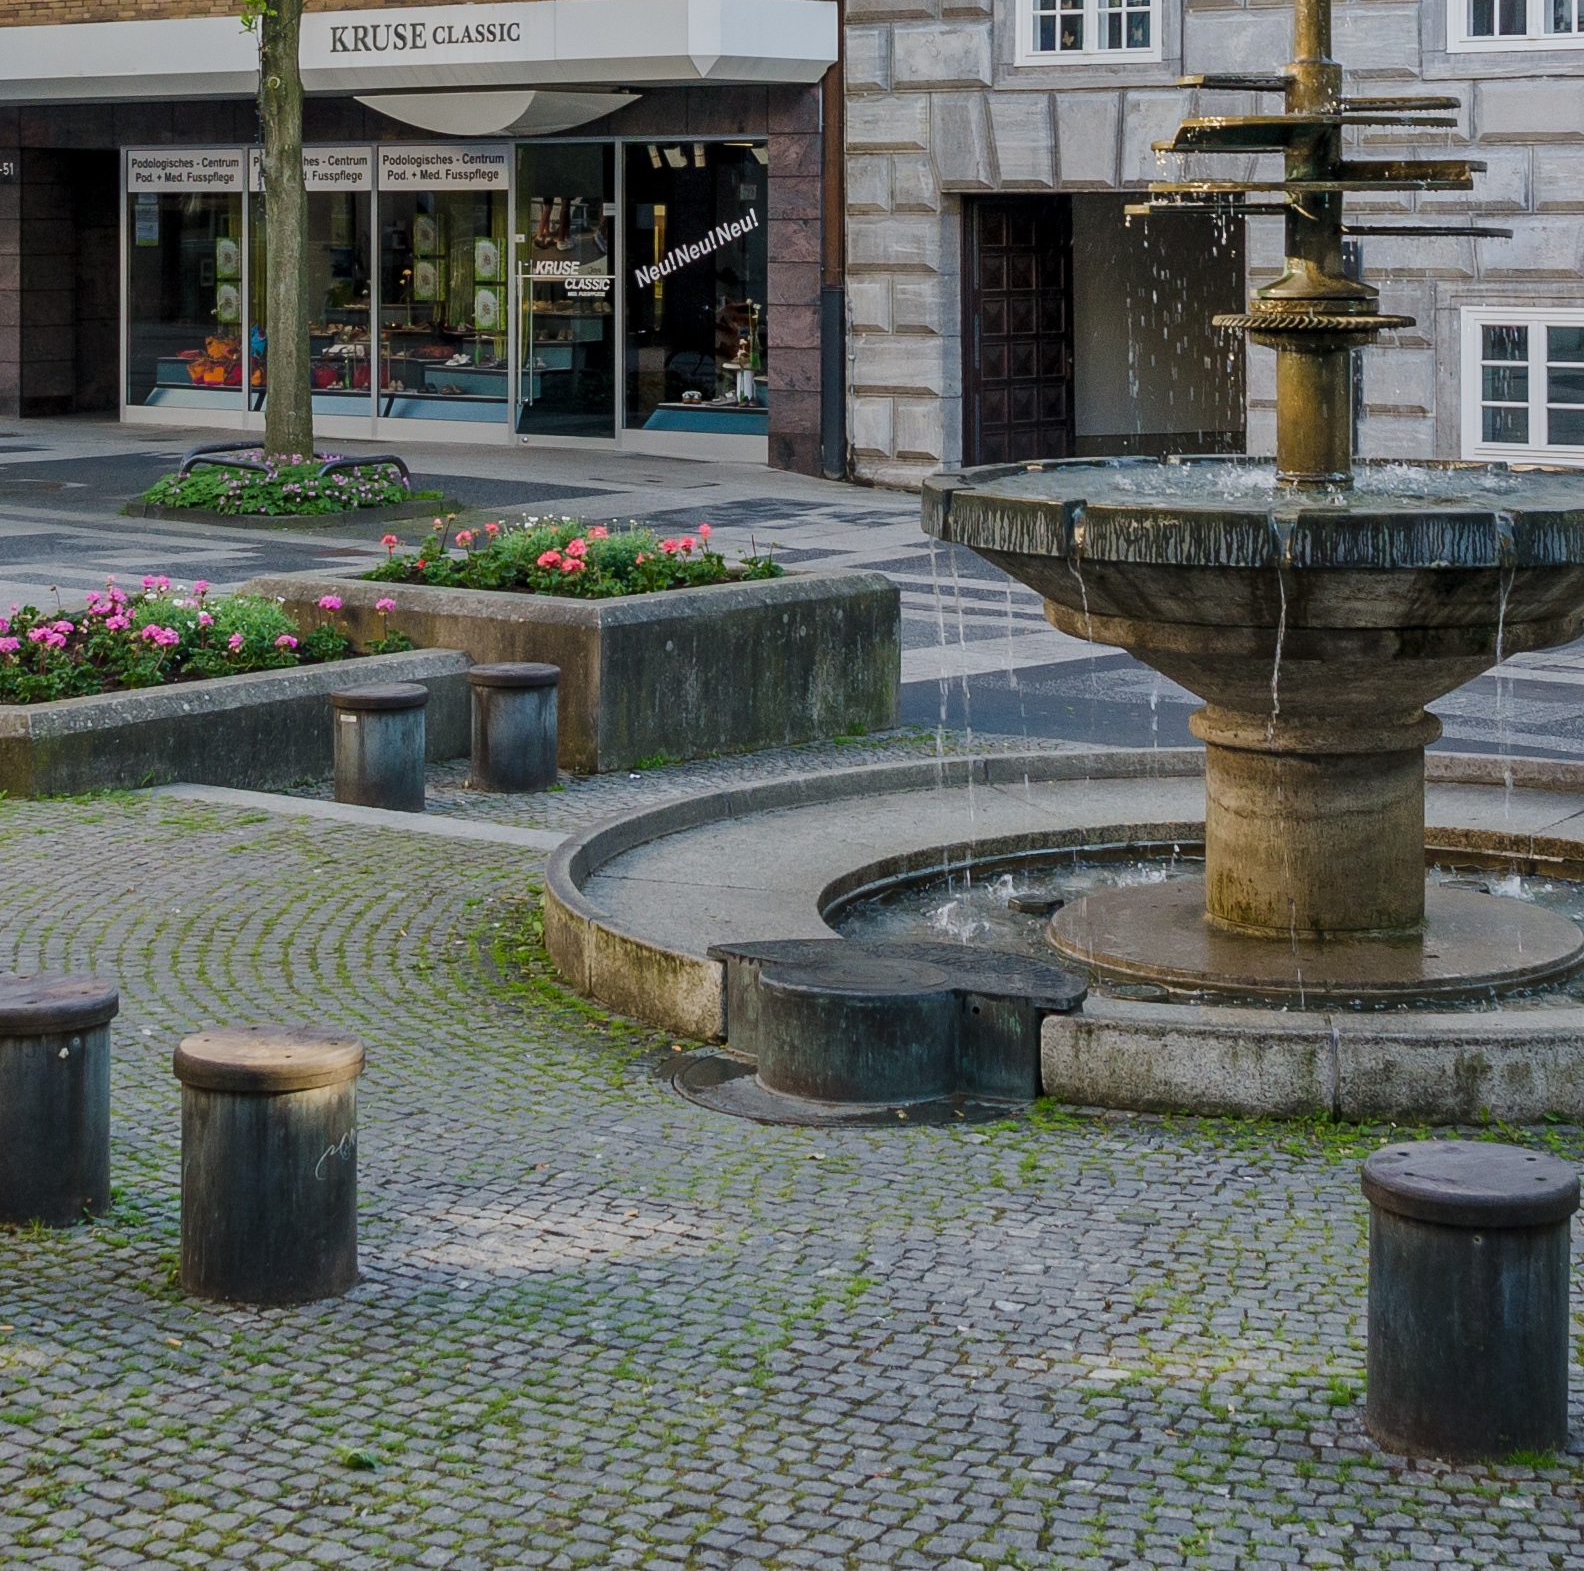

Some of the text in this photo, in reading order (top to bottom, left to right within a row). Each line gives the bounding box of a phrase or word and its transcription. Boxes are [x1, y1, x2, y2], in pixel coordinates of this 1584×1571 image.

[330, 22, 521, 53] KRUSE CLASSIC
[131, 158, 194, 171] Podologisches
[202, 157, 239, 168] Centrum
[328, 155, 367, 166] Centrum
[383, 154, 453, 167] Podologisches
[462, 152, 504, 164] Centrum
[136, 172, 154, 183] Pod.
[164, 172, 185, 183] Med.
[187, 172, 235, 185] Fusspflege
[312, 170, 363, 183] Fusspflege
[388, 170, 409, 181] Pod.
[420, 169, 442, 180] Med.
[445, 168, 499, 182] Fusspflege
[536, 260, 581, 276] KRUSE
[564, 278, 610, 291] CLASSIC
